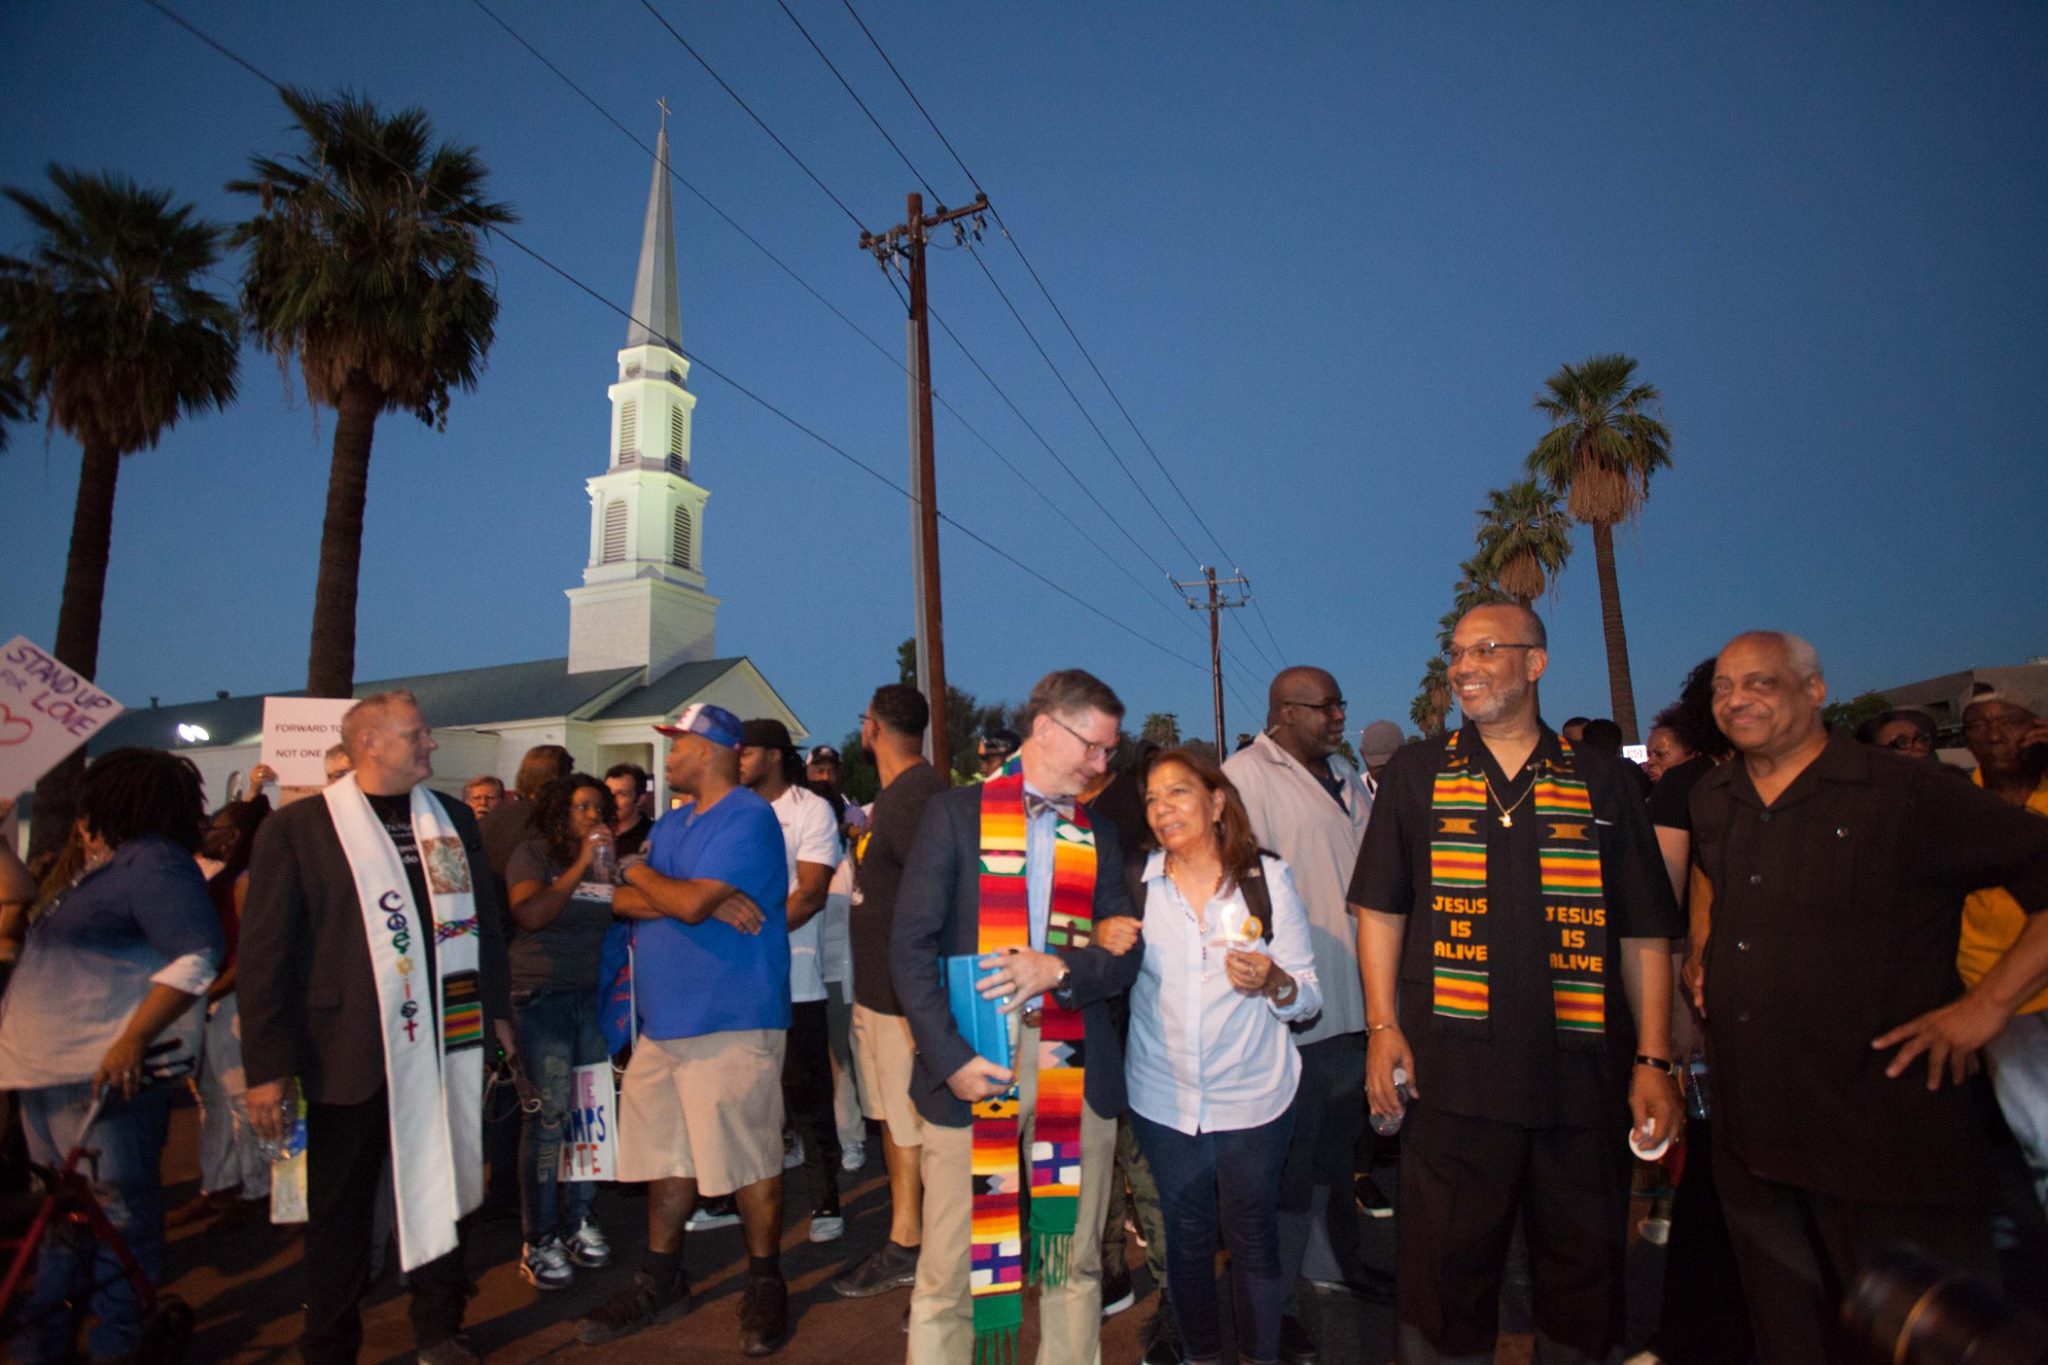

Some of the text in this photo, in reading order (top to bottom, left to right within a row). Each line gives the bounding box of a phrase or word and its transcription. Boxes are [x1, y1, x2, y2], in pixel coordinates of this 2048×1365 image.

[6, 647, 112, 710] STAND UP
[31, 691, 97, 736] LOVE
[275, 724, 328, 734] FORWARD
[276, 749, 321, 759] NOT ONE
[1431, 895, 1488, 915] JESUS
[1545, 906, 1607, 927] JESUS
[1450, 919, 1472, 938] IS
[1561, 929, 1586, 949] IS
[1433, 940, 1488, 962] ALIVE
[1550, 953, 1604, 973] ALIVE
